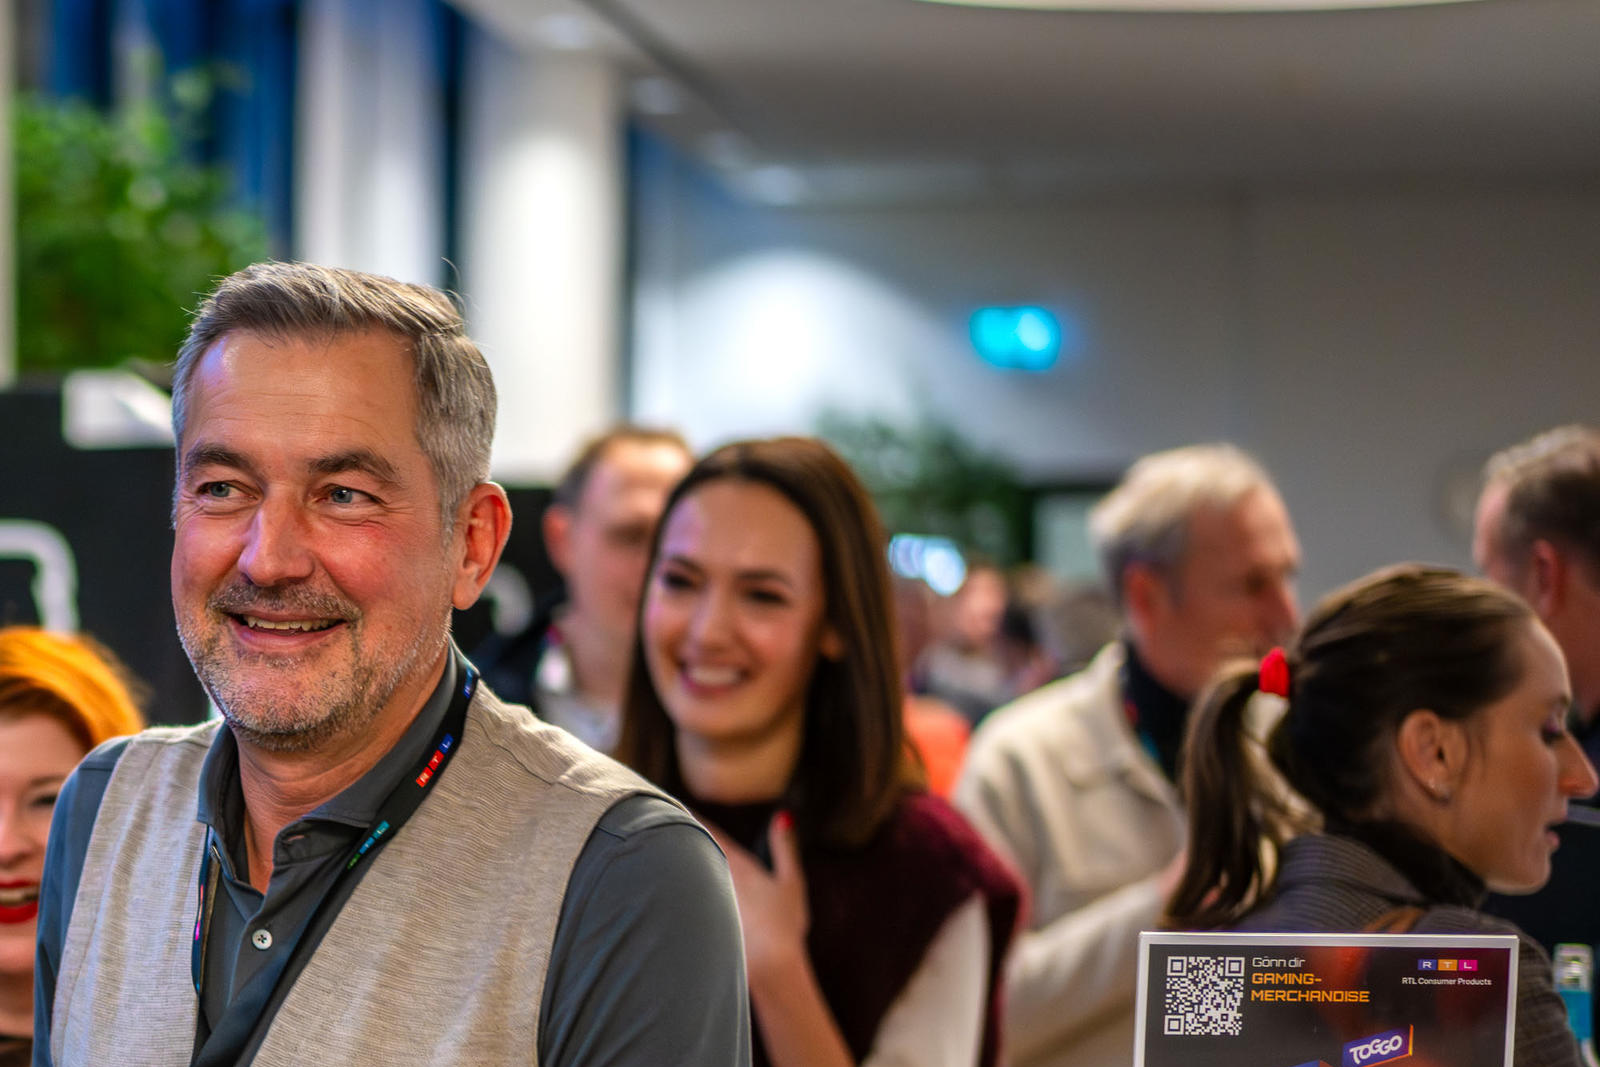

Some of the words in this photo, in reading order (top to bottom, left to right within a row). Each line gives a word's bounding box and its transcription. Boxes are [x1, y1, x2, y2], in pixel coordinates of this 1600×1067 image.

[1288, 957, 1306, 968] dir
[1252, 973, 1322, 985] GAMING-
[1402, 977, 1417, 985] RTL
[1418, 977, 1456, 985] Consumer
[1457, 978, 1492, 986] Products
[1251, 989, 1370, 1002] MERCHANDISE
[1349, 1035, 1402, 1064] TOGGO
